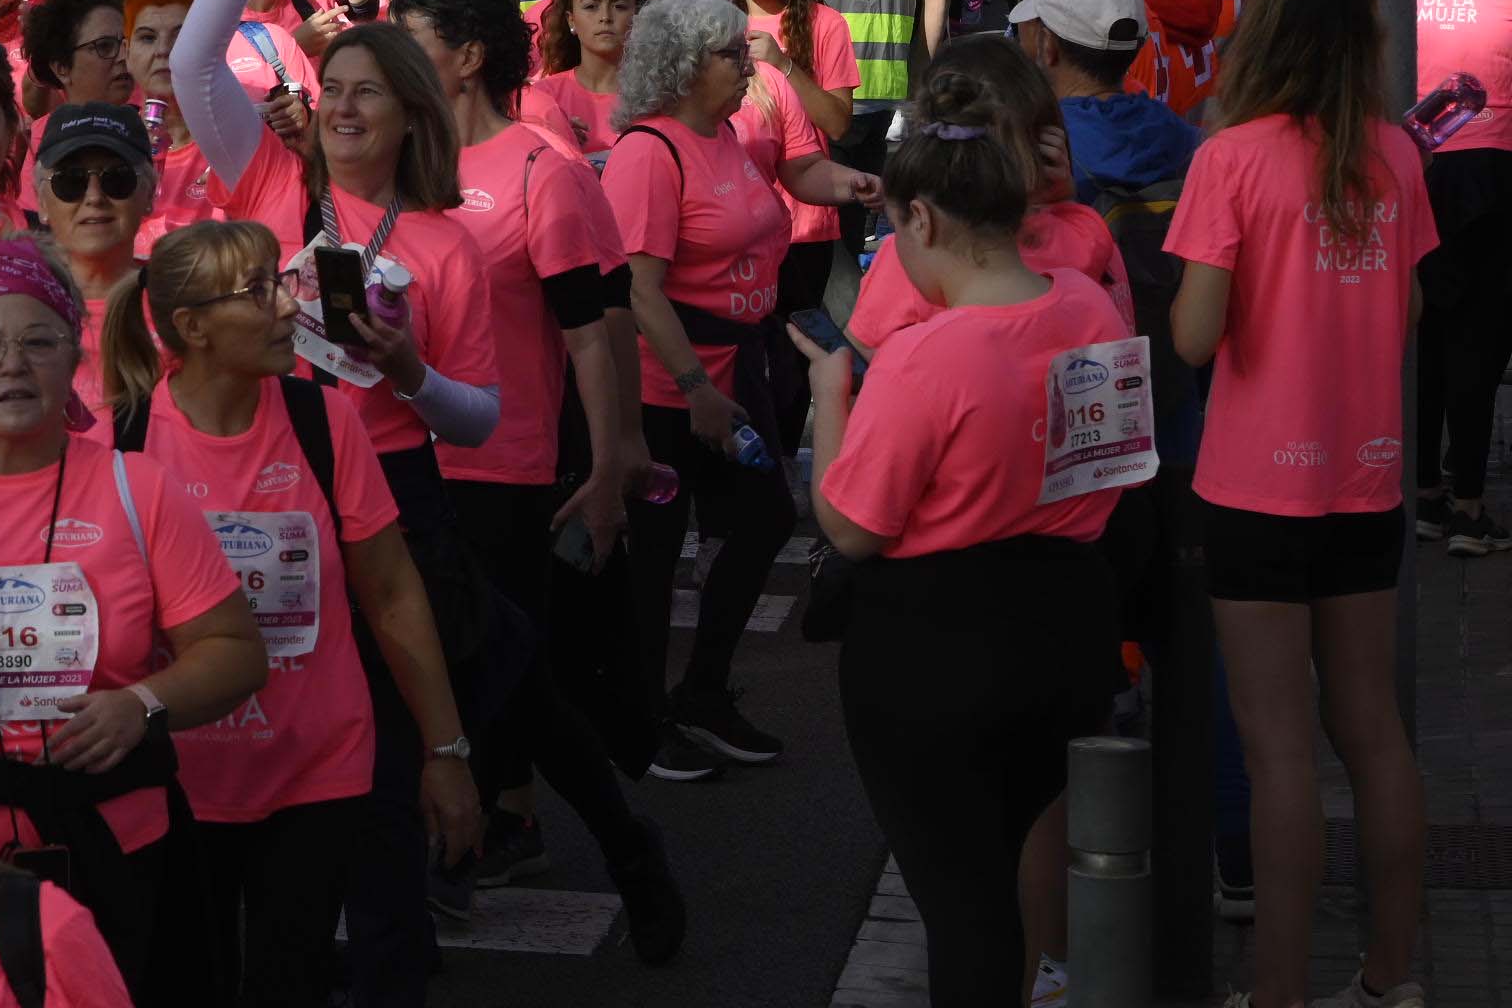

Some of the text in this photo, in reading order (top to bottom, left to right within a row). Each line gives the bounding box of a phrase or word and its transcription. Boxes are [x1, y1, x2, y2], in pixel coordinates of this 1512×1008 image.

[1417, 8, 1477, 23] MUJER
[1114, 360, 1140, 369] SUMA
[1068, 403, 1105, 429] 016
[1094, 446, 1120, 457] MUJER
[1103, 462, 1147, 477] Santander
[49, 530, 99, 541] STURIANA
[52, 582, 84, 593] SUMA
[7, 676, 20, 684] LA
[22, 675, 56, 683] MUJER
[60, 674, 82, 682] 2023
